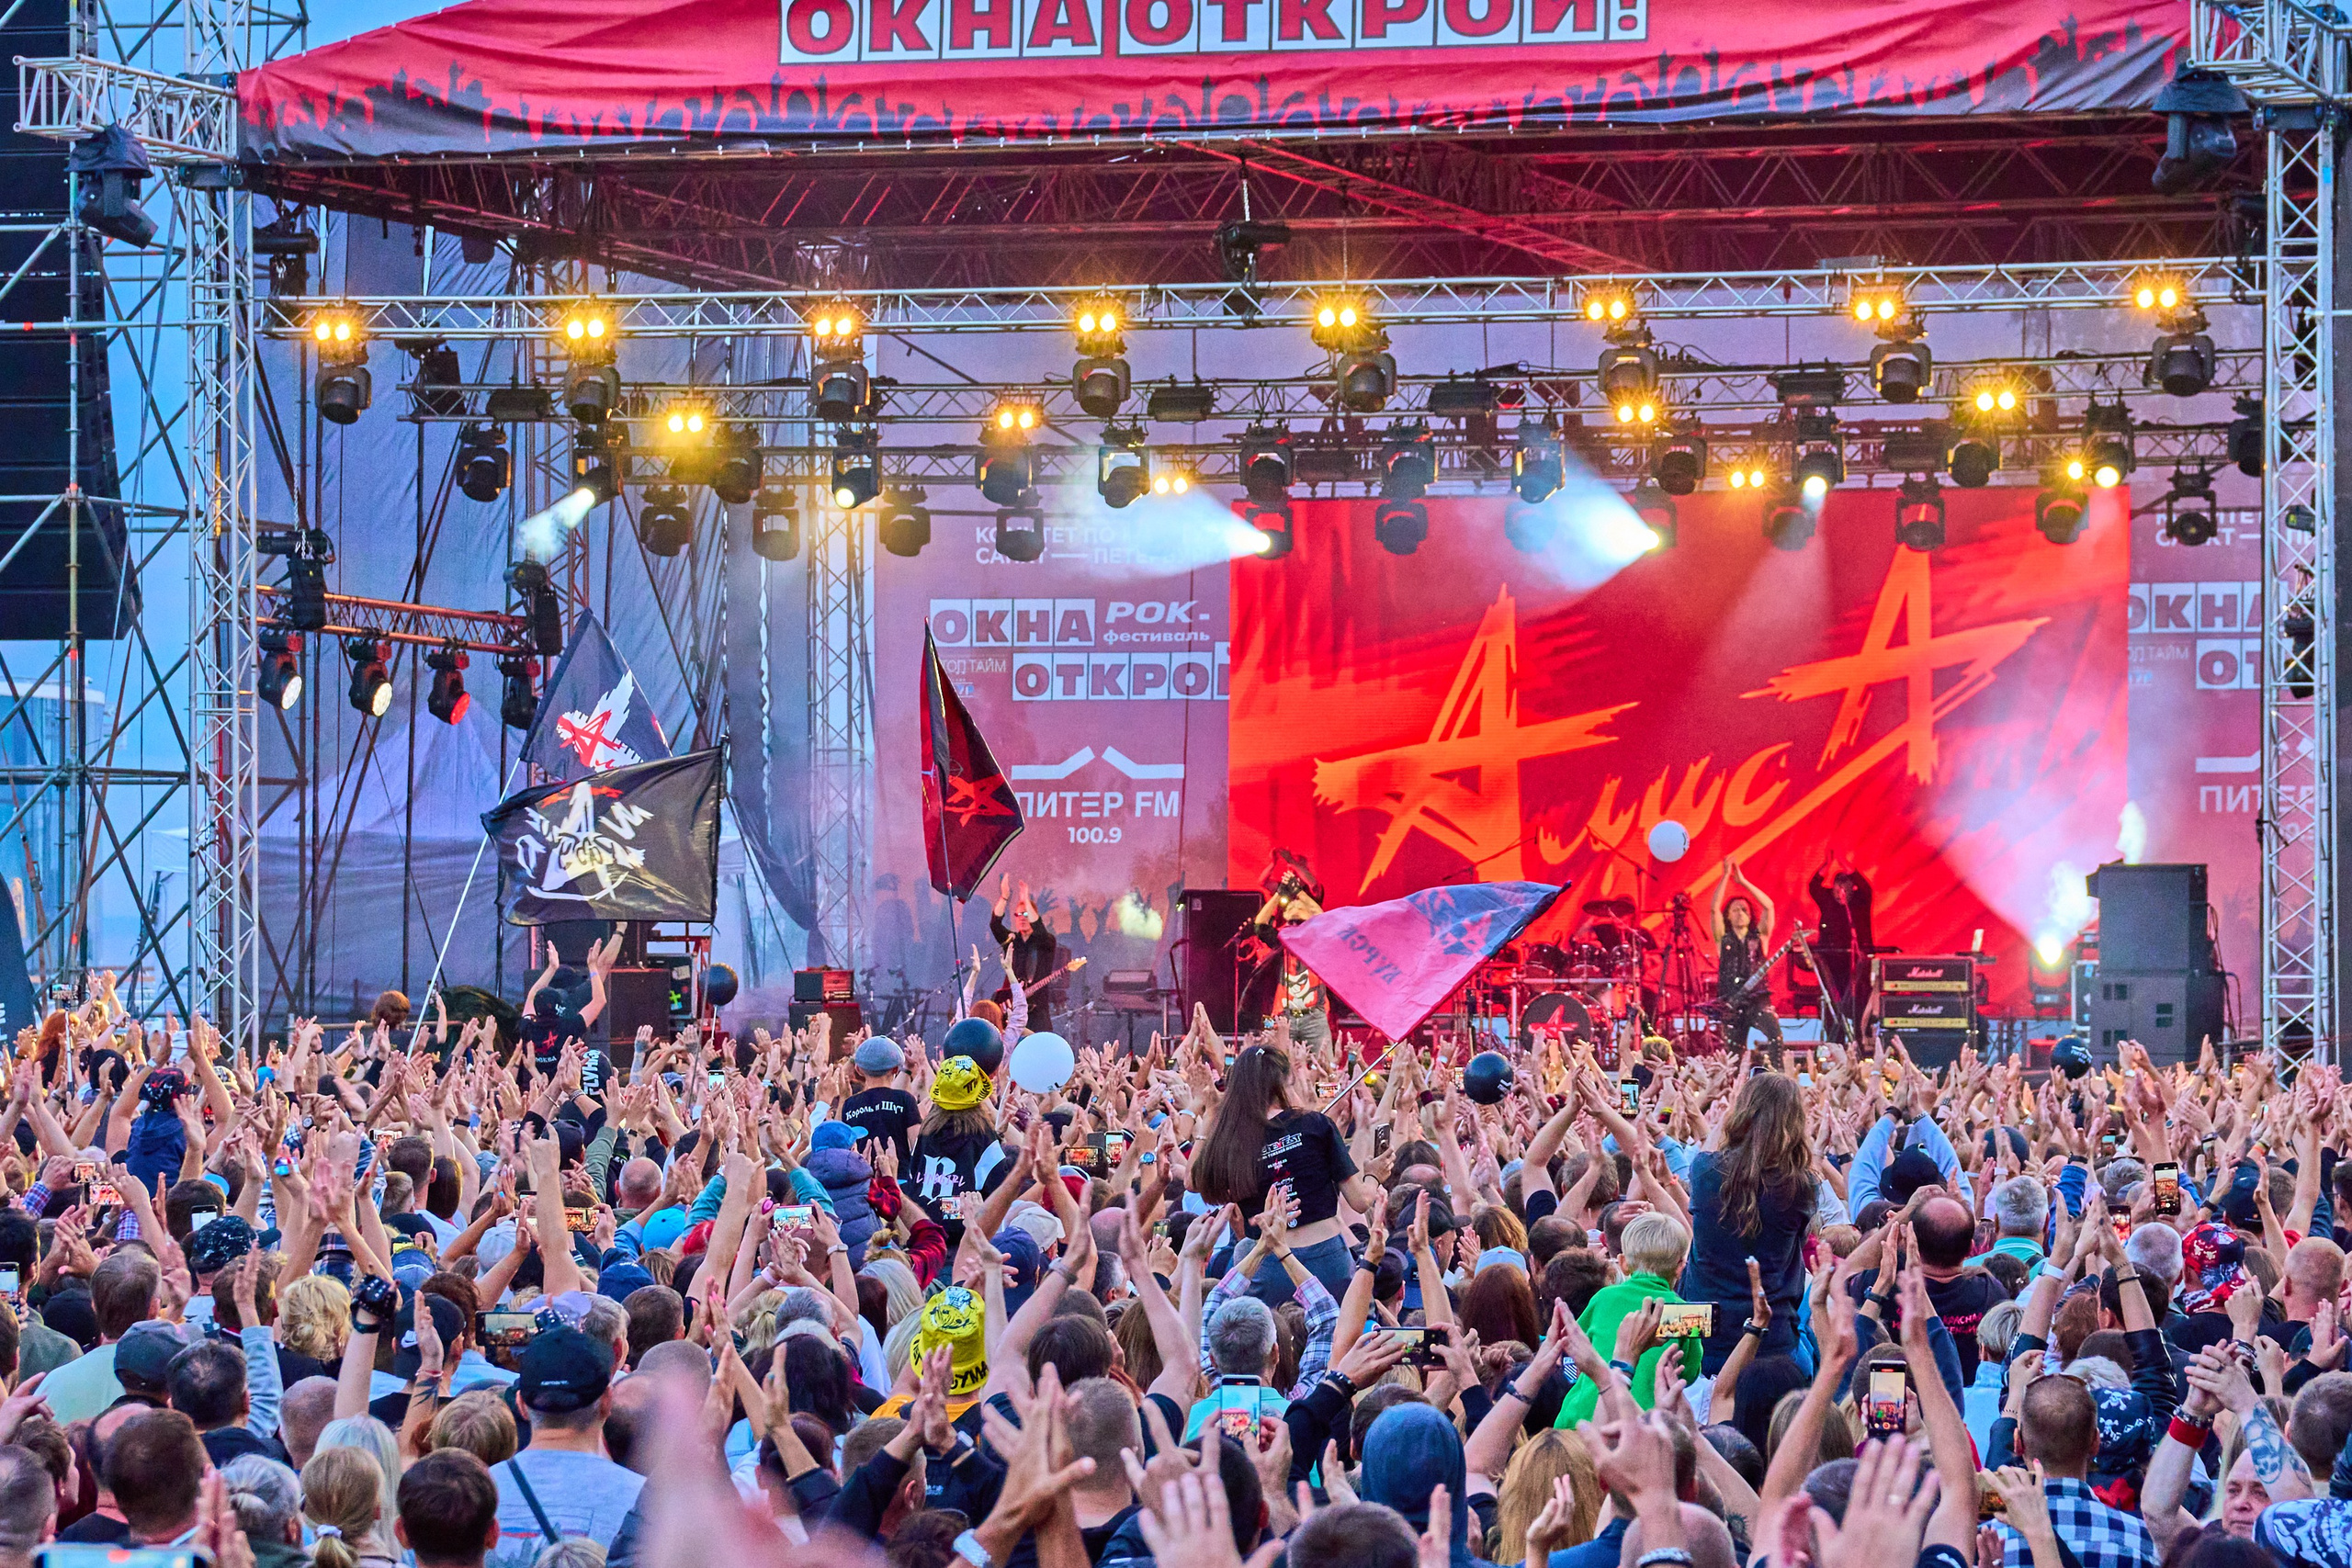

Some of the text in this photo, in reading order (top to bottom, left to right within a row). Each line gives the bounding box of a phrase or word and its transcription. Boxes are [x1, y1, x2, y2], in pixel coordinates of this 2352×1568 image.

[786, 0, 1099, 55] ОКНА
[976, 526, 1077, 544] КТЕТ
[1104, 601, 1211, 624] РОК-
[931, 609, 1092, 643] ОКНА
[1102, 628, 1211, 645] фестиваль
[1014, 791, 1180, 818] ПИТЕР FM
[1068, 827, 1123, 843] 100.9
[845, 1105, 875, 1122] Король
[881, 1100, 904, 1115] Шут
